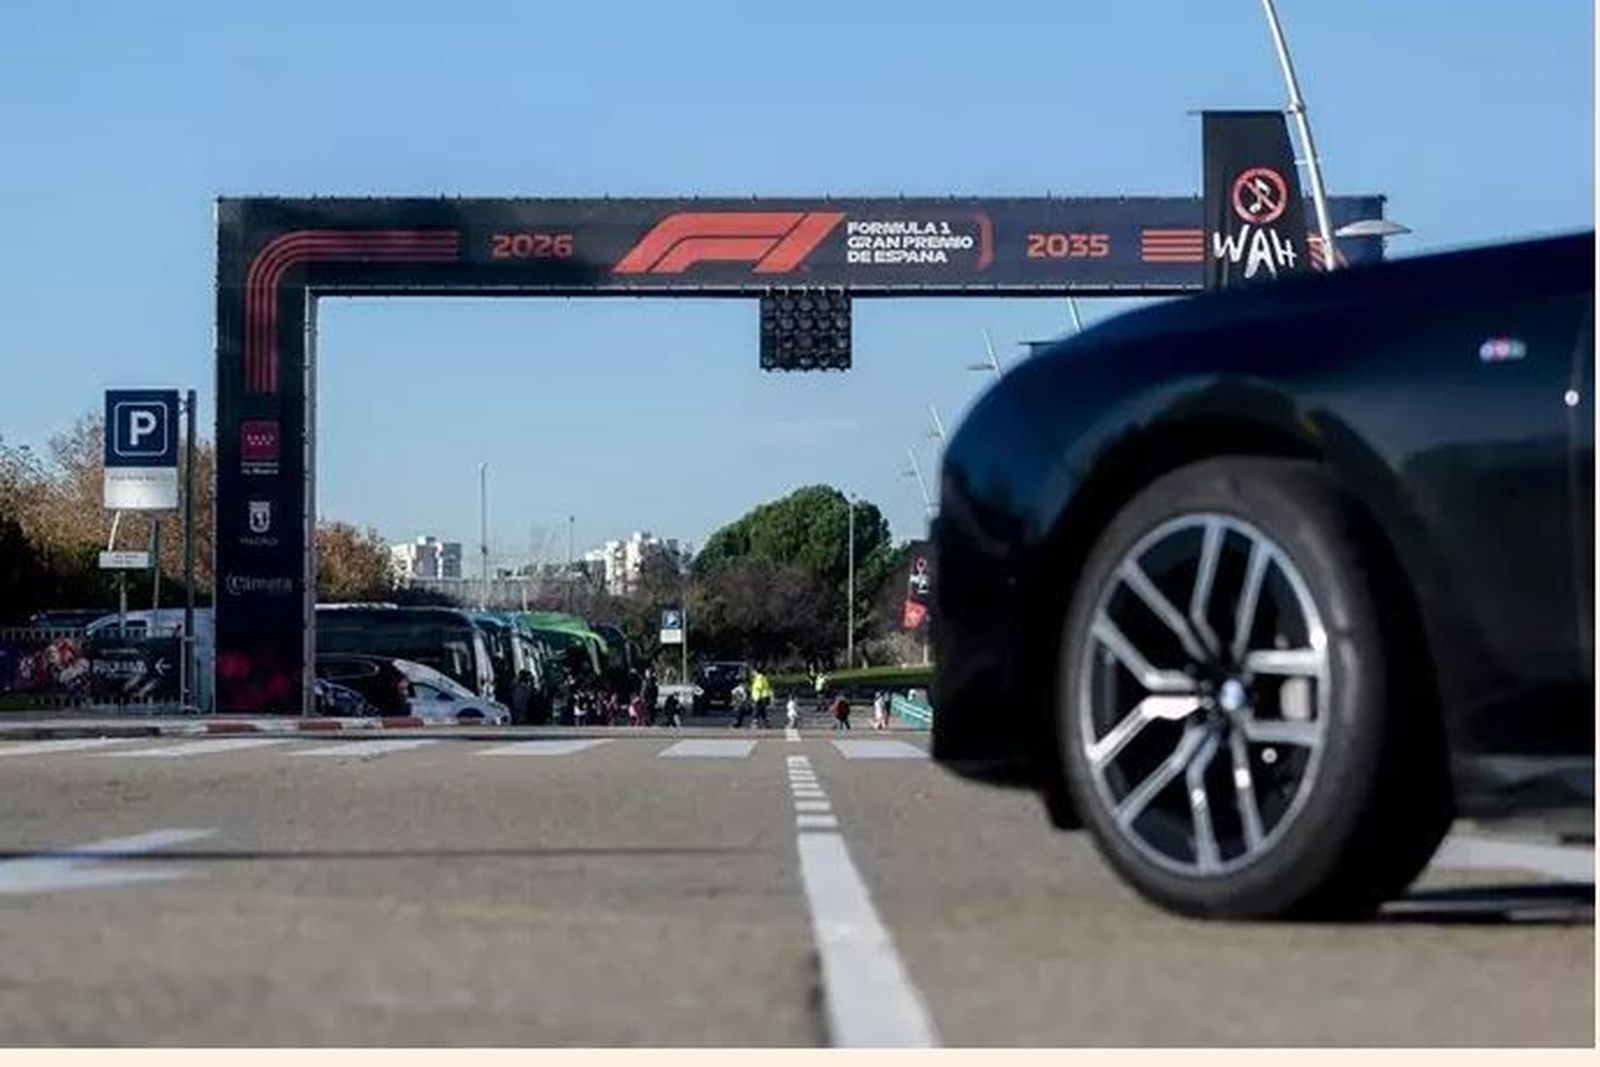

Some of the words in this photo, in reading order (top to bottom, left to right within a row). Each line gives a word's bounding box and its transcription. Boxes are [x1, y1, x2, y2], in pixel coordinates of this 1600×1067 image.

[847, 221, 938, 235] FORMULA
[940, 221, 951, 235] 1
[492, 233, 574, 258] 2026
[847, 236, 901, 249] GRAN
[903, 236, 974, 249] PREMIO
[1027, 233, 1110, 258] 2035
[1212, 223, 1297, 279] WAH
[847, 250, 871, 263] DE
[130, 410, 157, 446] P
